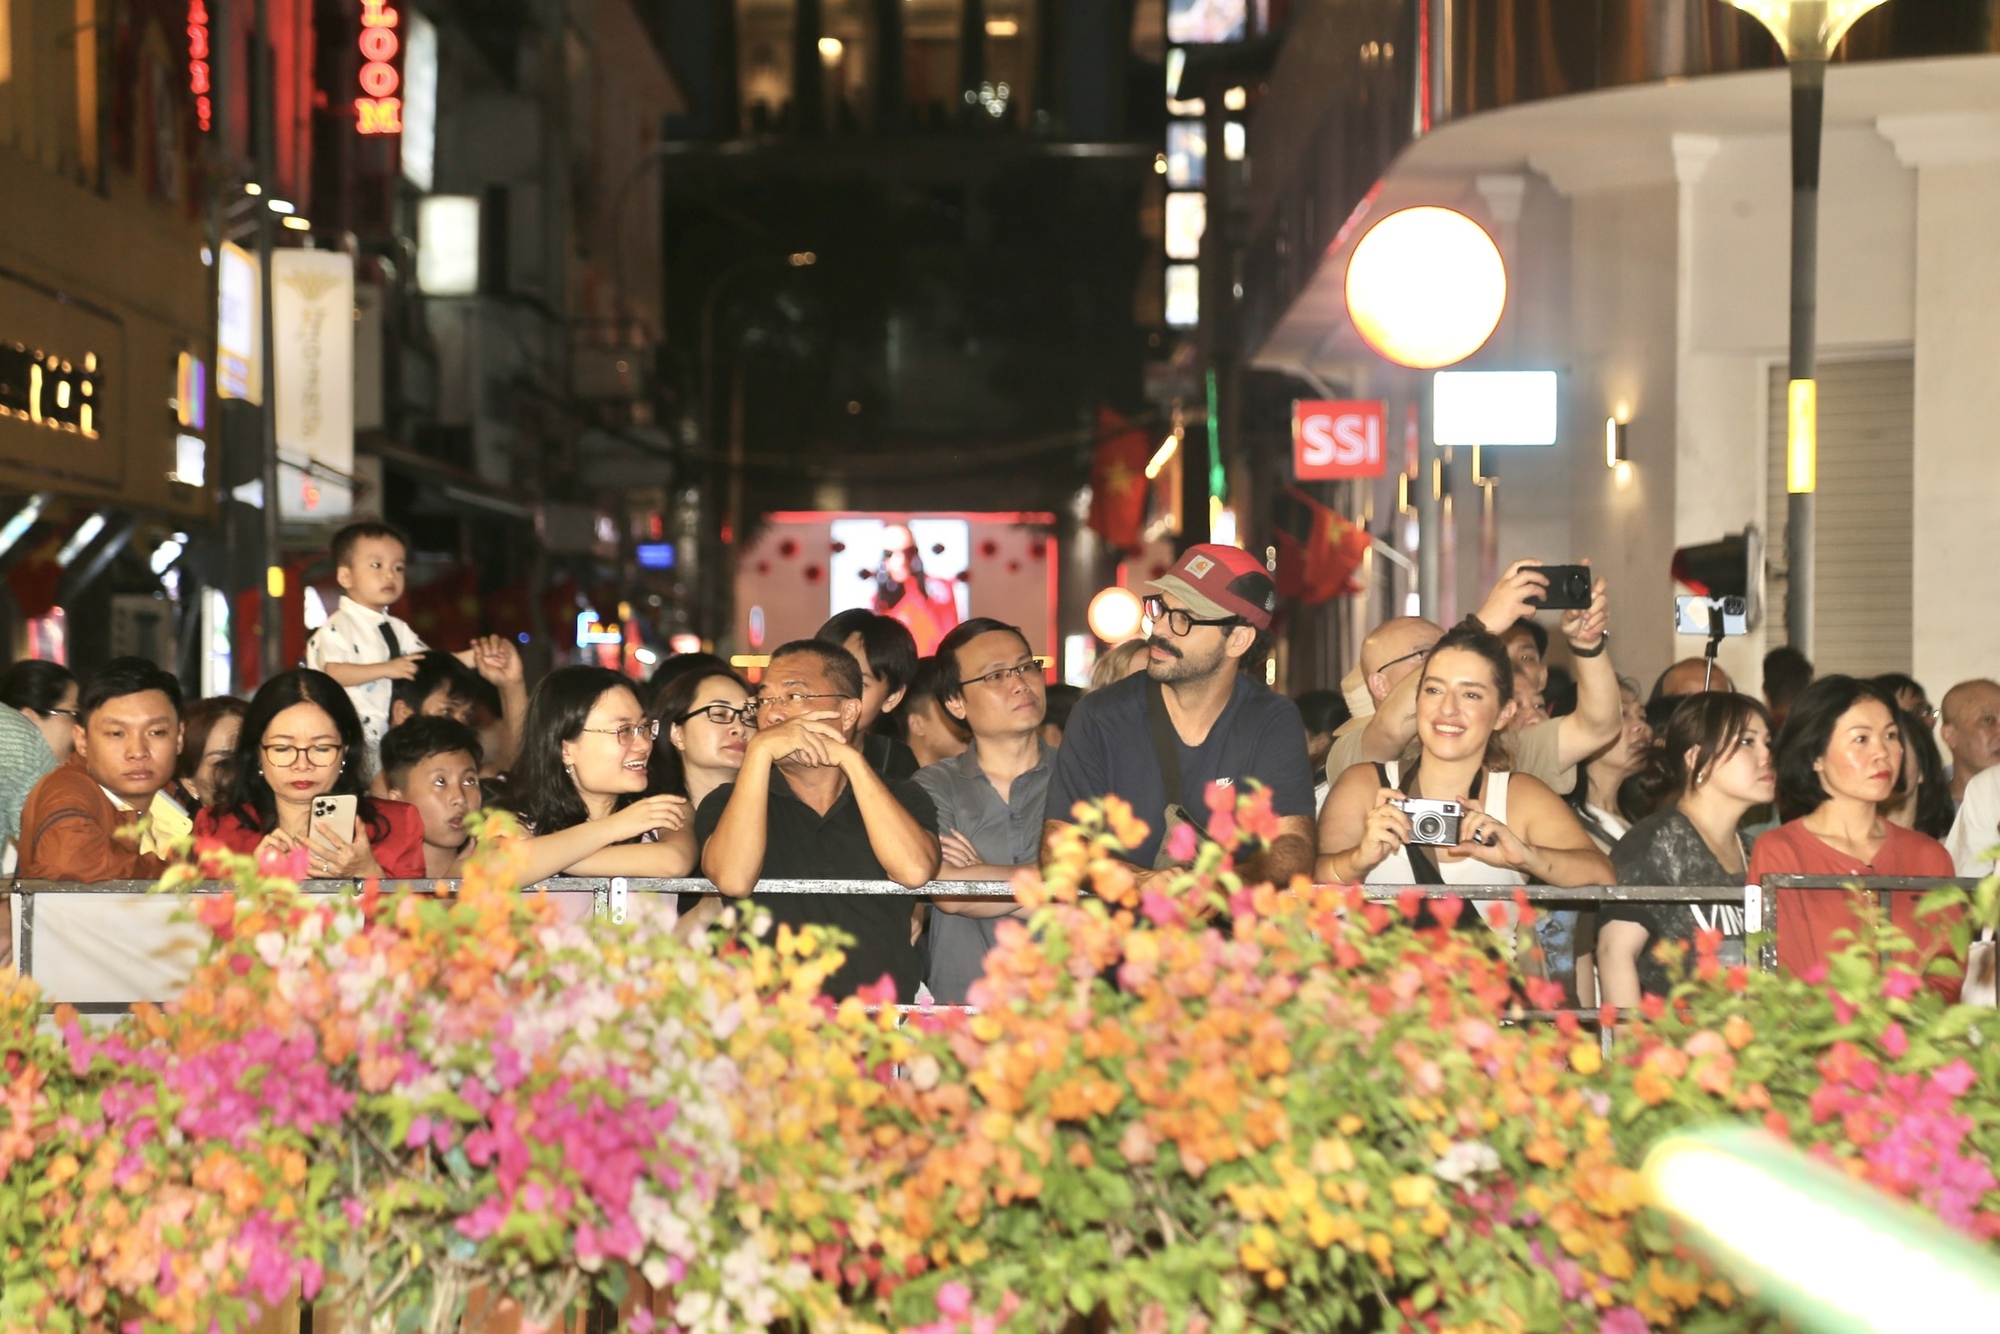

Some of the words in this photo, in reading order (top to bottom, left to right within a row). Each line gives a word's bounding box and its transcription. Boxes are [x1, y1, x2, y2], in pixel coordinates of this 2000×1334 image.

[355, 0, 403, 134] LOOM
[1302, 414, 1380, 466] SSI
[1689, 904, 1744, 936] VIN
